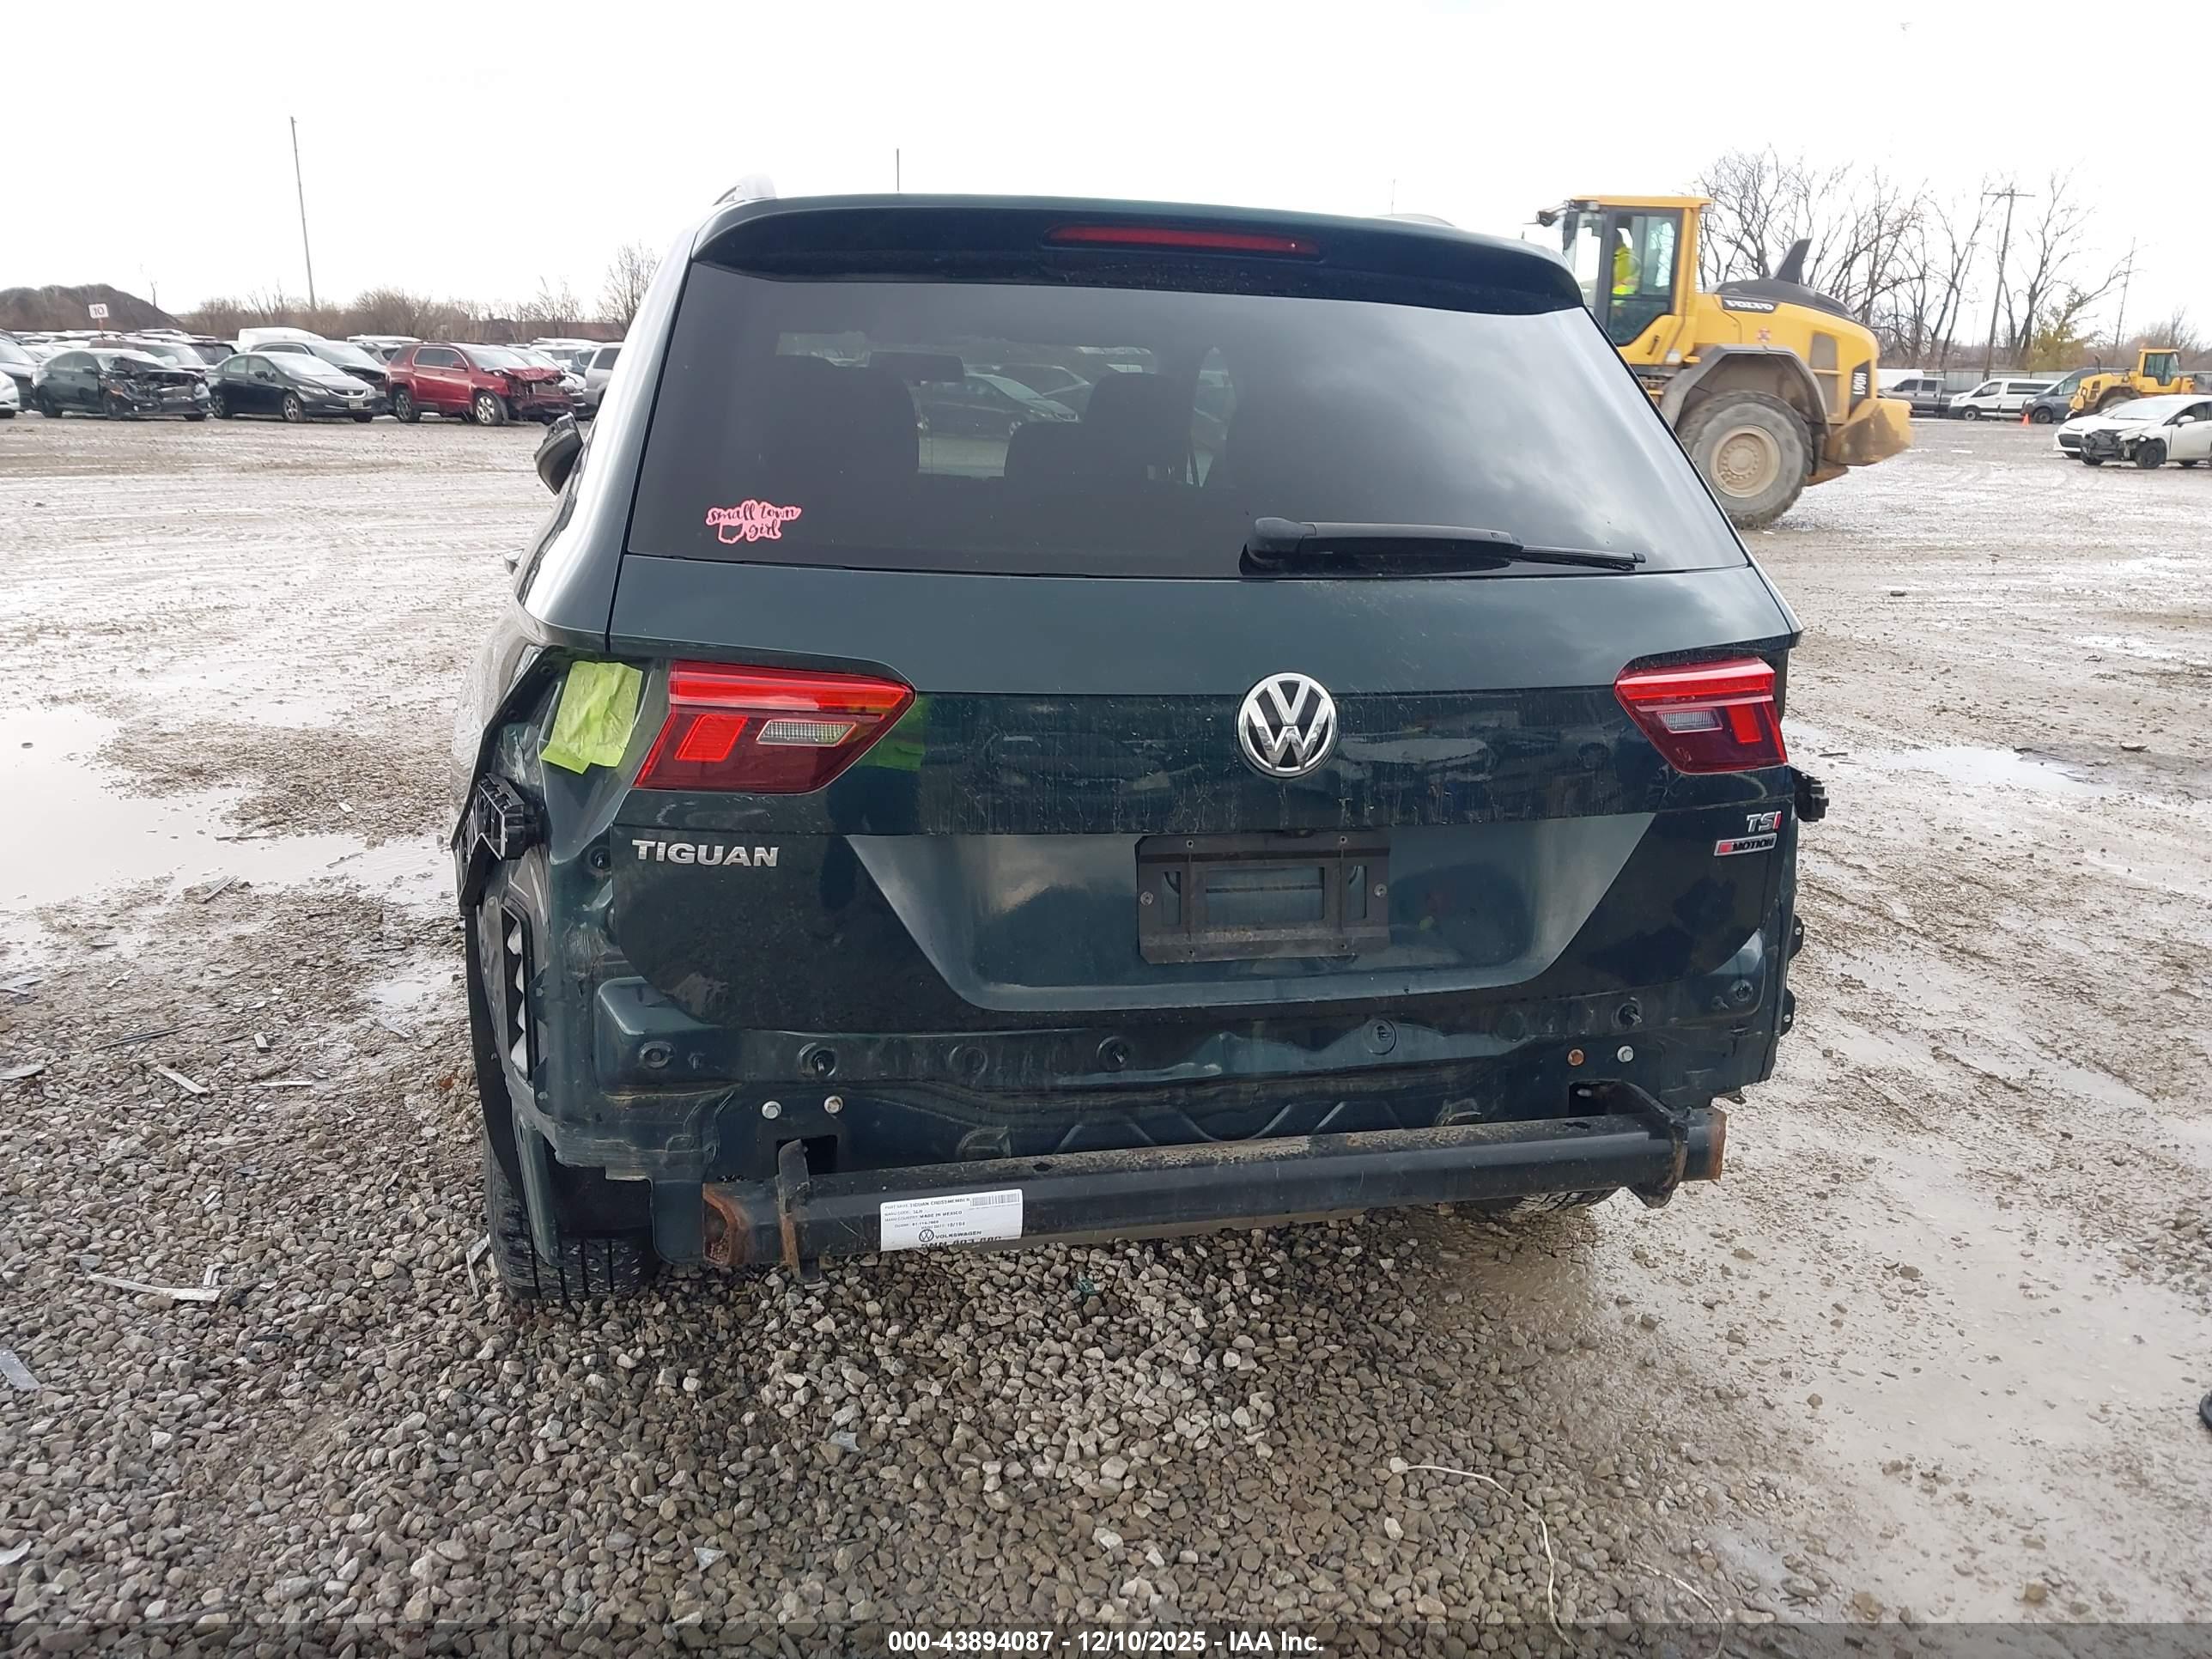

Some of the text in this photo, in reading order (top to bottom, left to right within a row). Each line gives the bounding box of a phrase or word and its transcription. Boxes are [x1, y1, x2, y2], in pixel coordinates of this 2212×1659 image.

[708, 502, 799, 523] small town
[749, 519, 779, 538] girl
[1746, 811, 1783, 832] TSI
[632, 839, 780, 867] TIGUAN
[935, 1231, 982, 1239] VOLKSWAGEN
